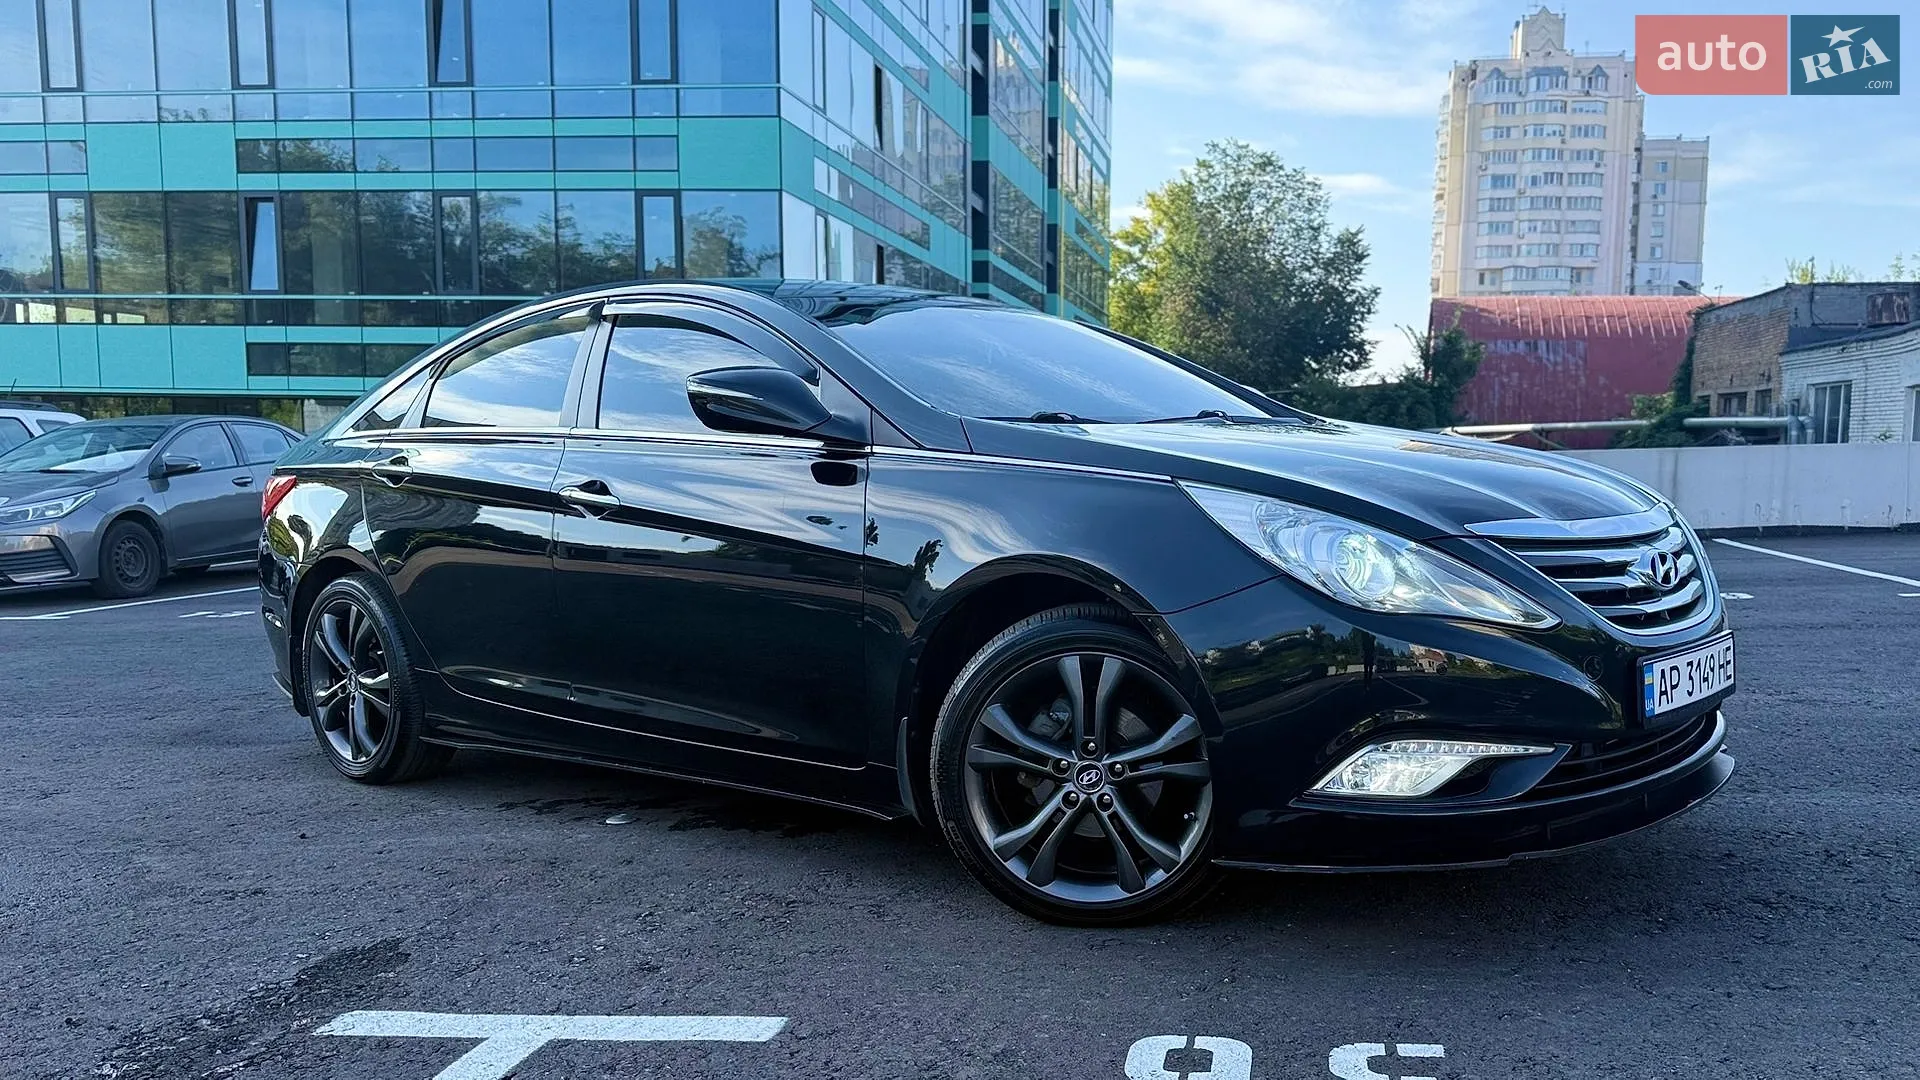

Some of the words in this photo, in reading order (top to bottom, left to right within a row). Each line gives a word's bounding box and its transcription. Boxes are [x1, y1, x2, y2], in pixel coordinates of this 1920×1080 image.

[1658, 664, 1681, 707] AP
[1686, 653, 1715, 697] 3149
[1718, 645, 1731, 684] HE
[1645, 701, 1654, 711] UA
